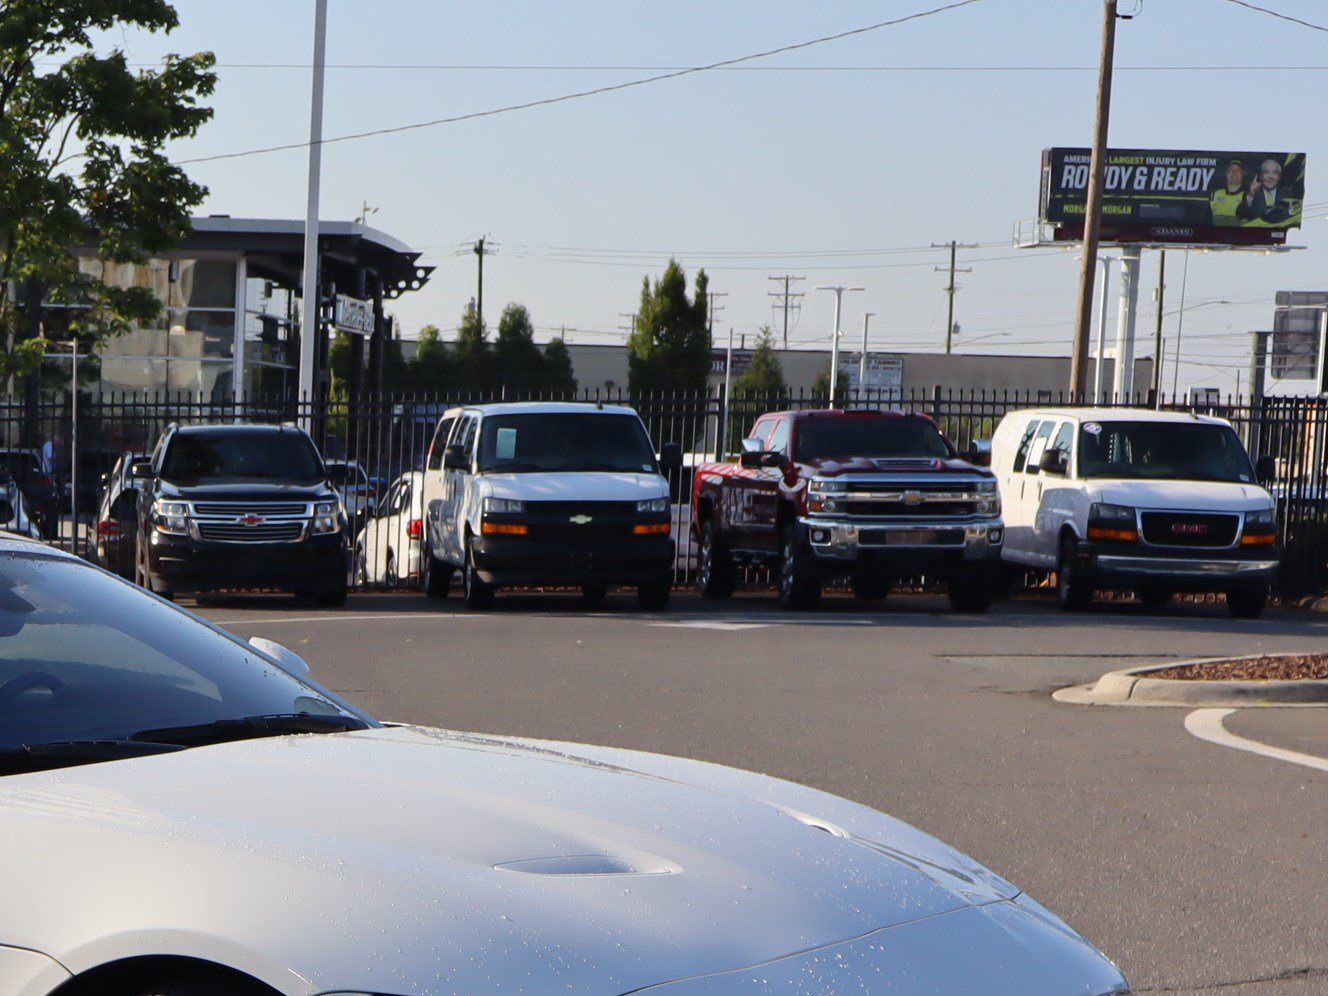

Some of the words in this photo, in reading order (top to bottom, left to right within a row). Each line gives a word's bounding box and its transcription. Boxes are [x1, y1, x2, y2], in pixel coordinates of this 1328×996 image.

[1109, 156, 1145, 164] LARGEST
[1146, 157, 1176, 165] INJURY
[1177, 157, 1195, 166] LAW
[1196, 158, 1217, 166] FIRM
[1061, 165, 1134, 189] RODY
[1133, 166, 1149, 190] &
[1150, 167, 1215, 191] READY
[1063, 204, 1087, 213] MORGA
[1101, 205, 1132, 214] MORGAN
